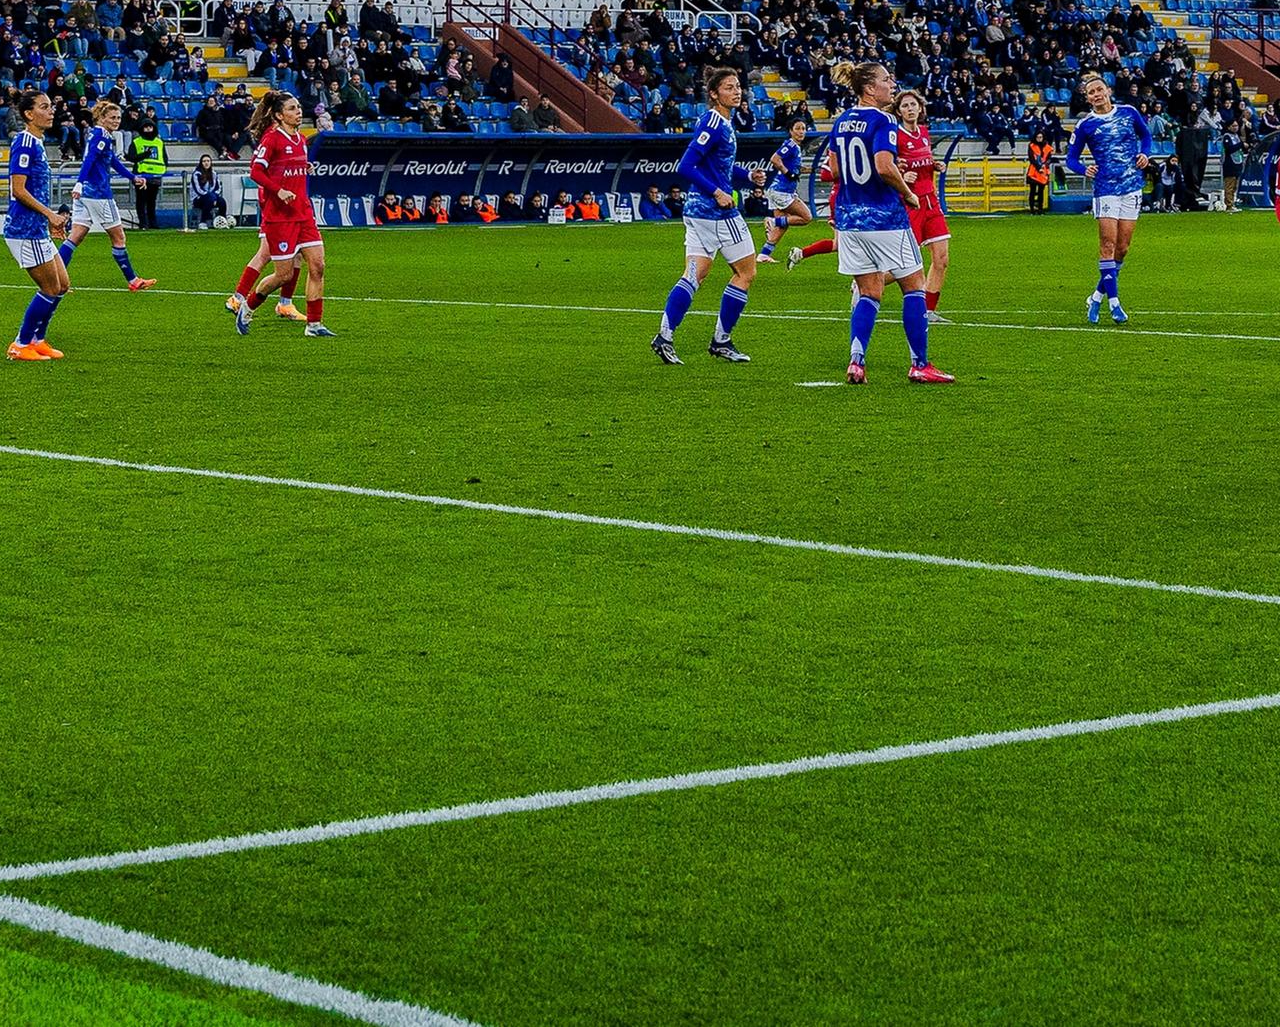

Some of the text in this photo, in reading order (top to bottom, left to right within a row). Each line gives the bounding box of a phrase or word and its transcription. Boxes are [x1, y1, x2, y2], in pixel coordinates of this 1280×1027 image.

[404, 160, 467, 175] Revolut
[499, 160, 514, 175] R
[544, 159, 605, 174] Revolut
[836, 136, 872, 185] 10
